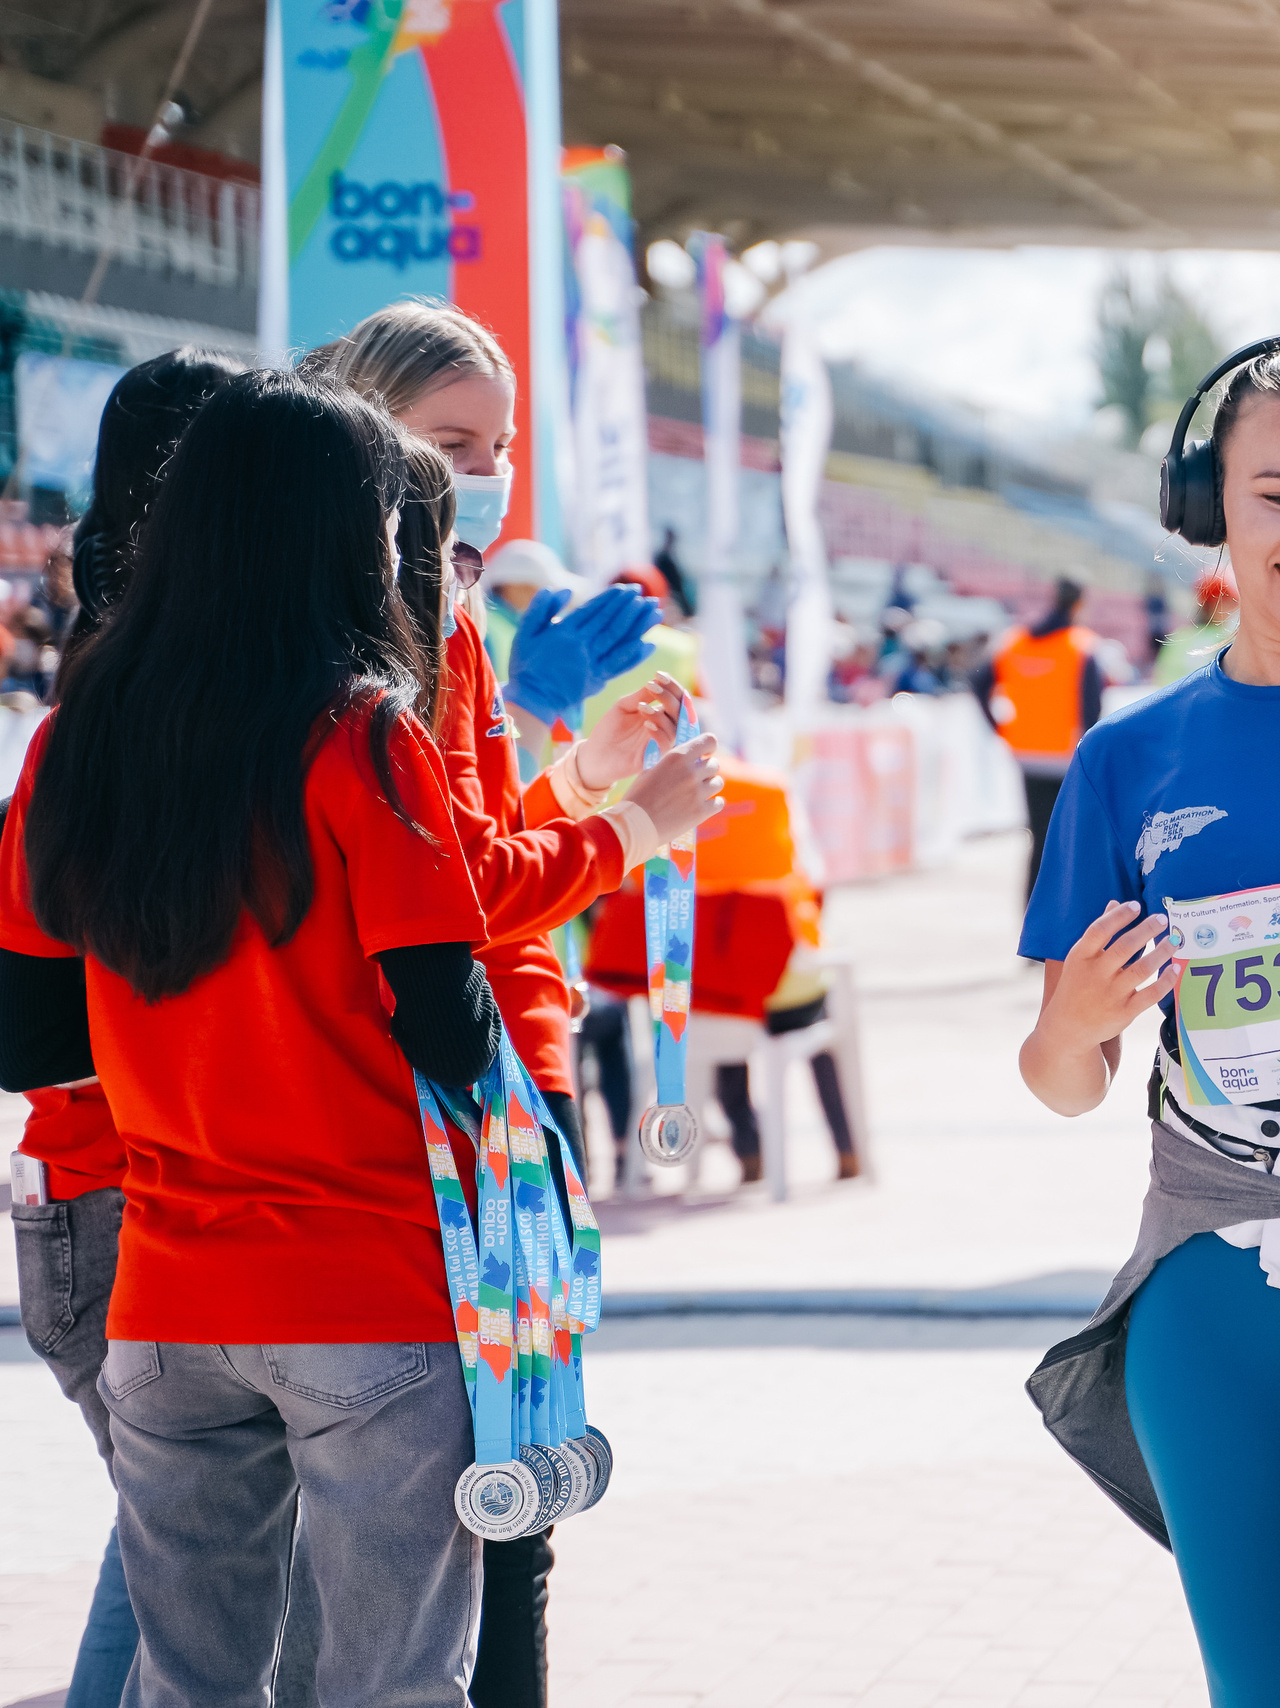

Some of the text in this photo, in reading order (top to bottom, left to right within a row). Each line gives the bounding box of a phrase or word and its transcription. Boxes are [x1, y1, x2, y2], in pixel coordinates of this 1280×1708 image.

[330, 225, 484, 274] aqua
[1154, 809, 1214, 829] SCO MARATHON
[1163, 821, 1180, 831] RUN
[1168, 826, 1184, 835] SILK
[1162, 833, 1183, 844] ROAD
[648, 900, 659, 920] SCO
[668, 888, 680, 930] aqua
[1191, 908, 1219, 917] Culture,
[1220, 900, 1261, 912] Information,
[1222, 1076, 1259, 1091] aqua
[512, 1135, 522, 1164] RUN
[519, 1127, 530, 1155] SILK
[527, 1128, 540, 1165] ROAD
[430, 1153, 442, 1180] RUN
[435, 1144, 448, 1172] SILK
[442, 1143, 459, 1180] ROAD
[482, 1198, 496, 1247] aqua
[520, 1213, 532, 1236] SCO
[571, 1202, 583, 1231] RUN
[580, 1194, 598, 1230] ROAD
[459, 1226, 478, 1301] MARATHON
[536, 1212, 549, 1287] MARATHON
[445, 1229, 468, 1303] Issyk Kul SCO
[569, 1277, 584, 1316] Kul SCO
[480, 1307, 490, 1345] ROAD
[490, 1317, 500, 1347] SILK
[499, 1308, 510, 1338] RUN
[519, 1318, 530, 1355] ROAD
[539, 1318, 549, 1355] ROAD
[462, 1340, 477, 1369] RUN
[459, 1469, 477, 1492] finisher
[511, 1464, 526, 1480] There
[535, 1460, 550, 1478] KUL
[554, 1461, 569, 1478] KUL
[561, 1450, 576, 1466] There
[575, 1475, 583, 1494] better
[524, 1479, 532, 1489] are
[560, 1480, 571, 1499] SCO
[460, 1491, 469, 1512] strong
[527, 1490, 535, 1507] better
[478, 1525, 487, 1534] but
[500, 1525, 513, 1534] than
[512, 1506, 531, 1528] starters
